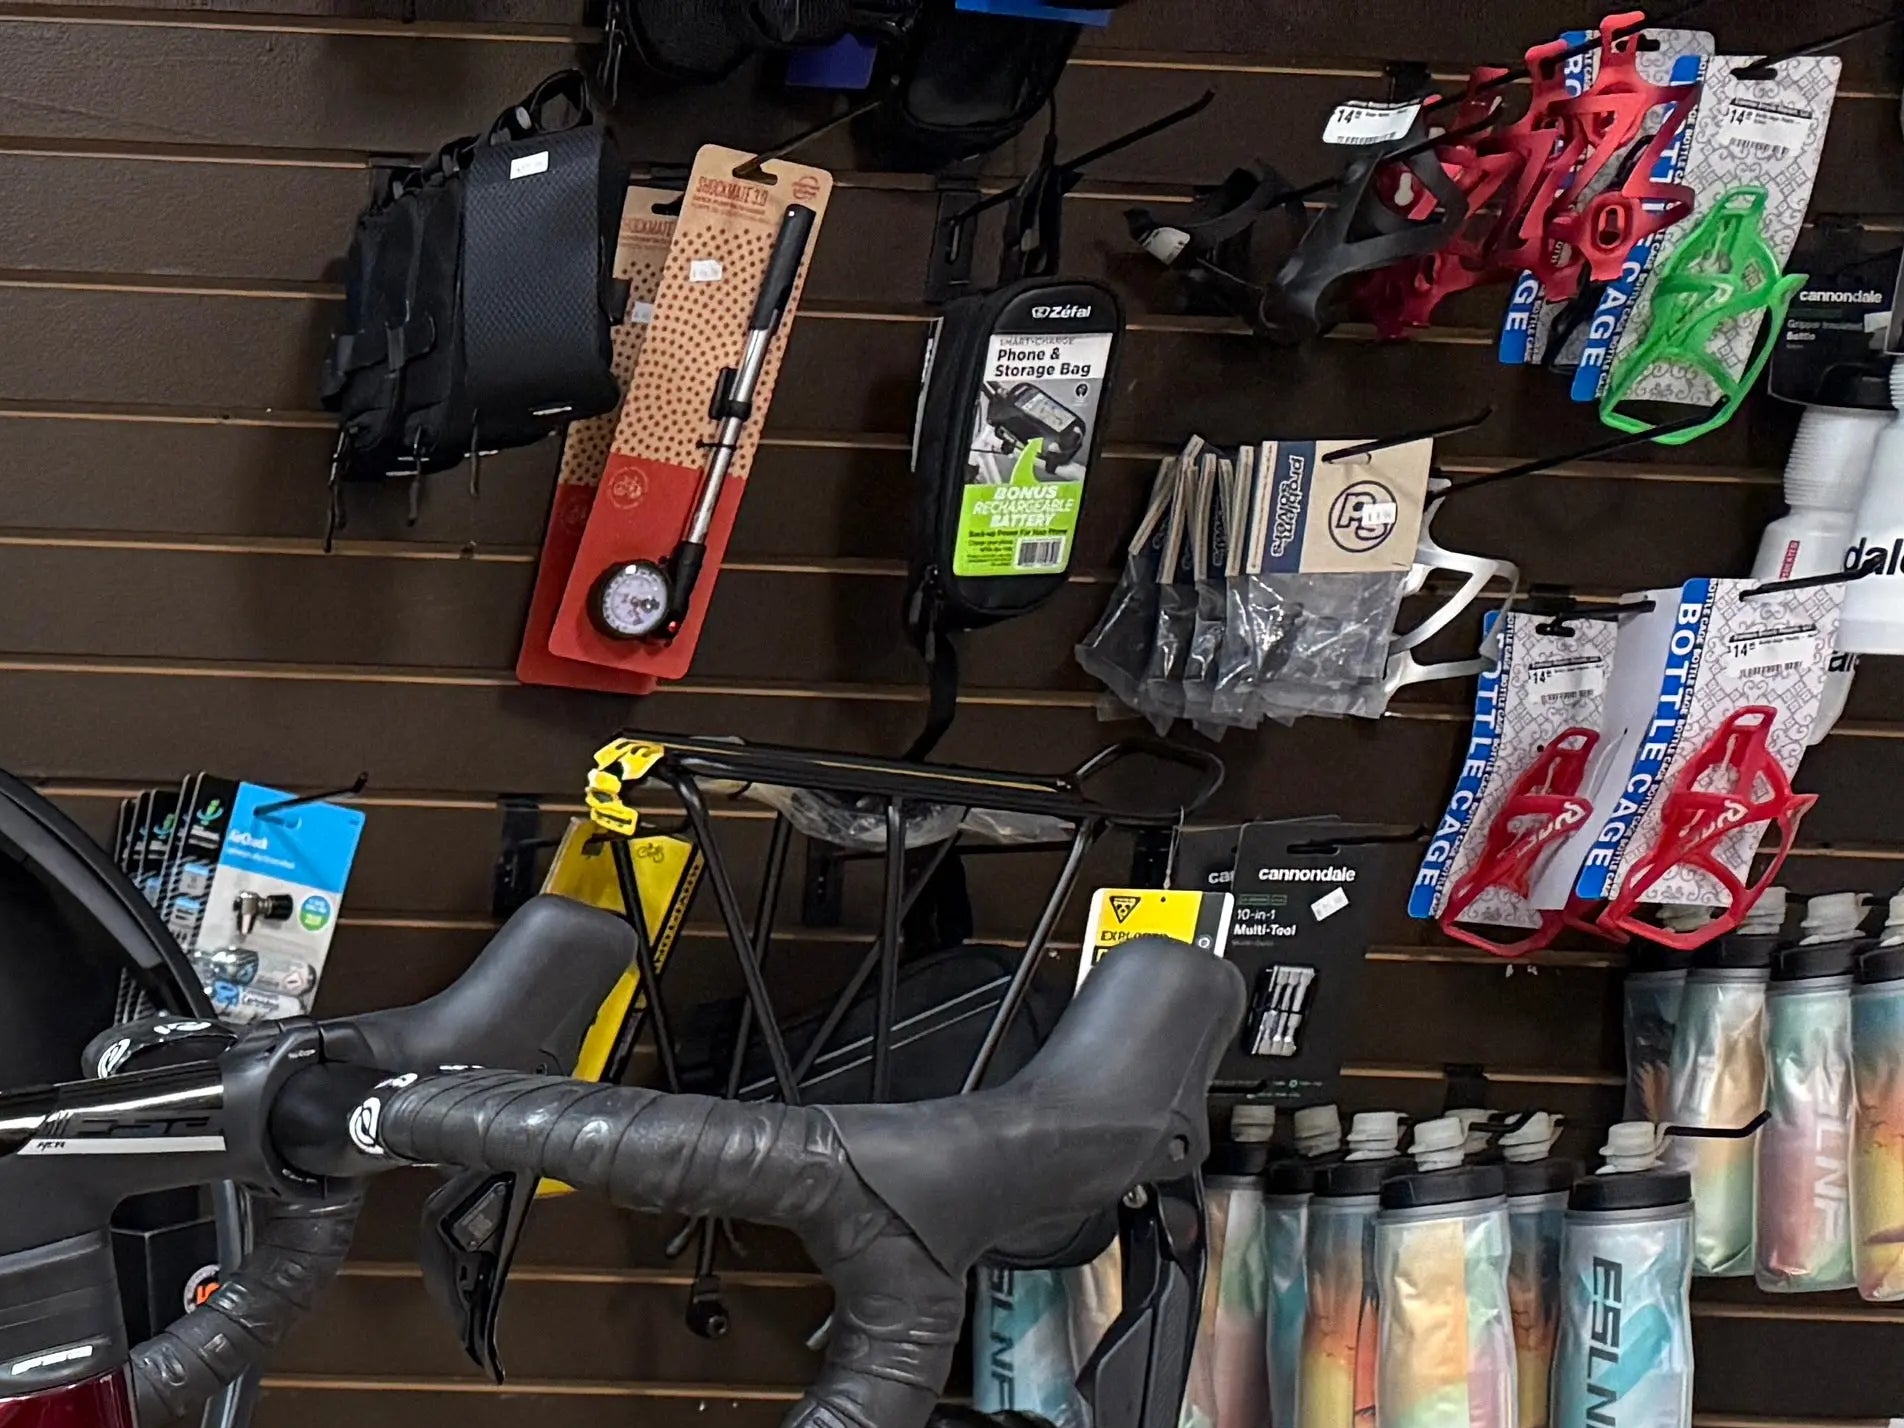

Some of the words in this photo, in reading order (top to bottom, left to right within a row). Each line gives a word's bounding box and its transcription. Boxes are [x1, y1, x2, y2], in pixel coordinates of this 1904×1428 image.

[1800, 290, 1883, 303] cannondale
[1049, 305, 1092, 319] Zéfal
[1580, 262, 1642, 368] CAGE
[997, 348, 1046, 361] Phone
[1050, 348, 1060, 360] &
[994, 364, 1056, 378] Storage
[1059, 363, 1092, 378] Bag
[994, 485, 1059, 501] BONUS
[972, 499, 1076, 516] RECHARGEABLE
[990, 514, 1057, 529] BATTERY
[1640, 602, 1701, 762] BOTTLE
[1585, 772, 1653, 868] CAGE
[1416, 789, 1474, 888] CAGE
[1258, 866, 1356, 883] cannondale
[1237, 909, 1276, 921] 10-in-1
[1233, 924, 1297, 937] Multi-Tool
[990, 1267, 1016, 1410] SLNF
